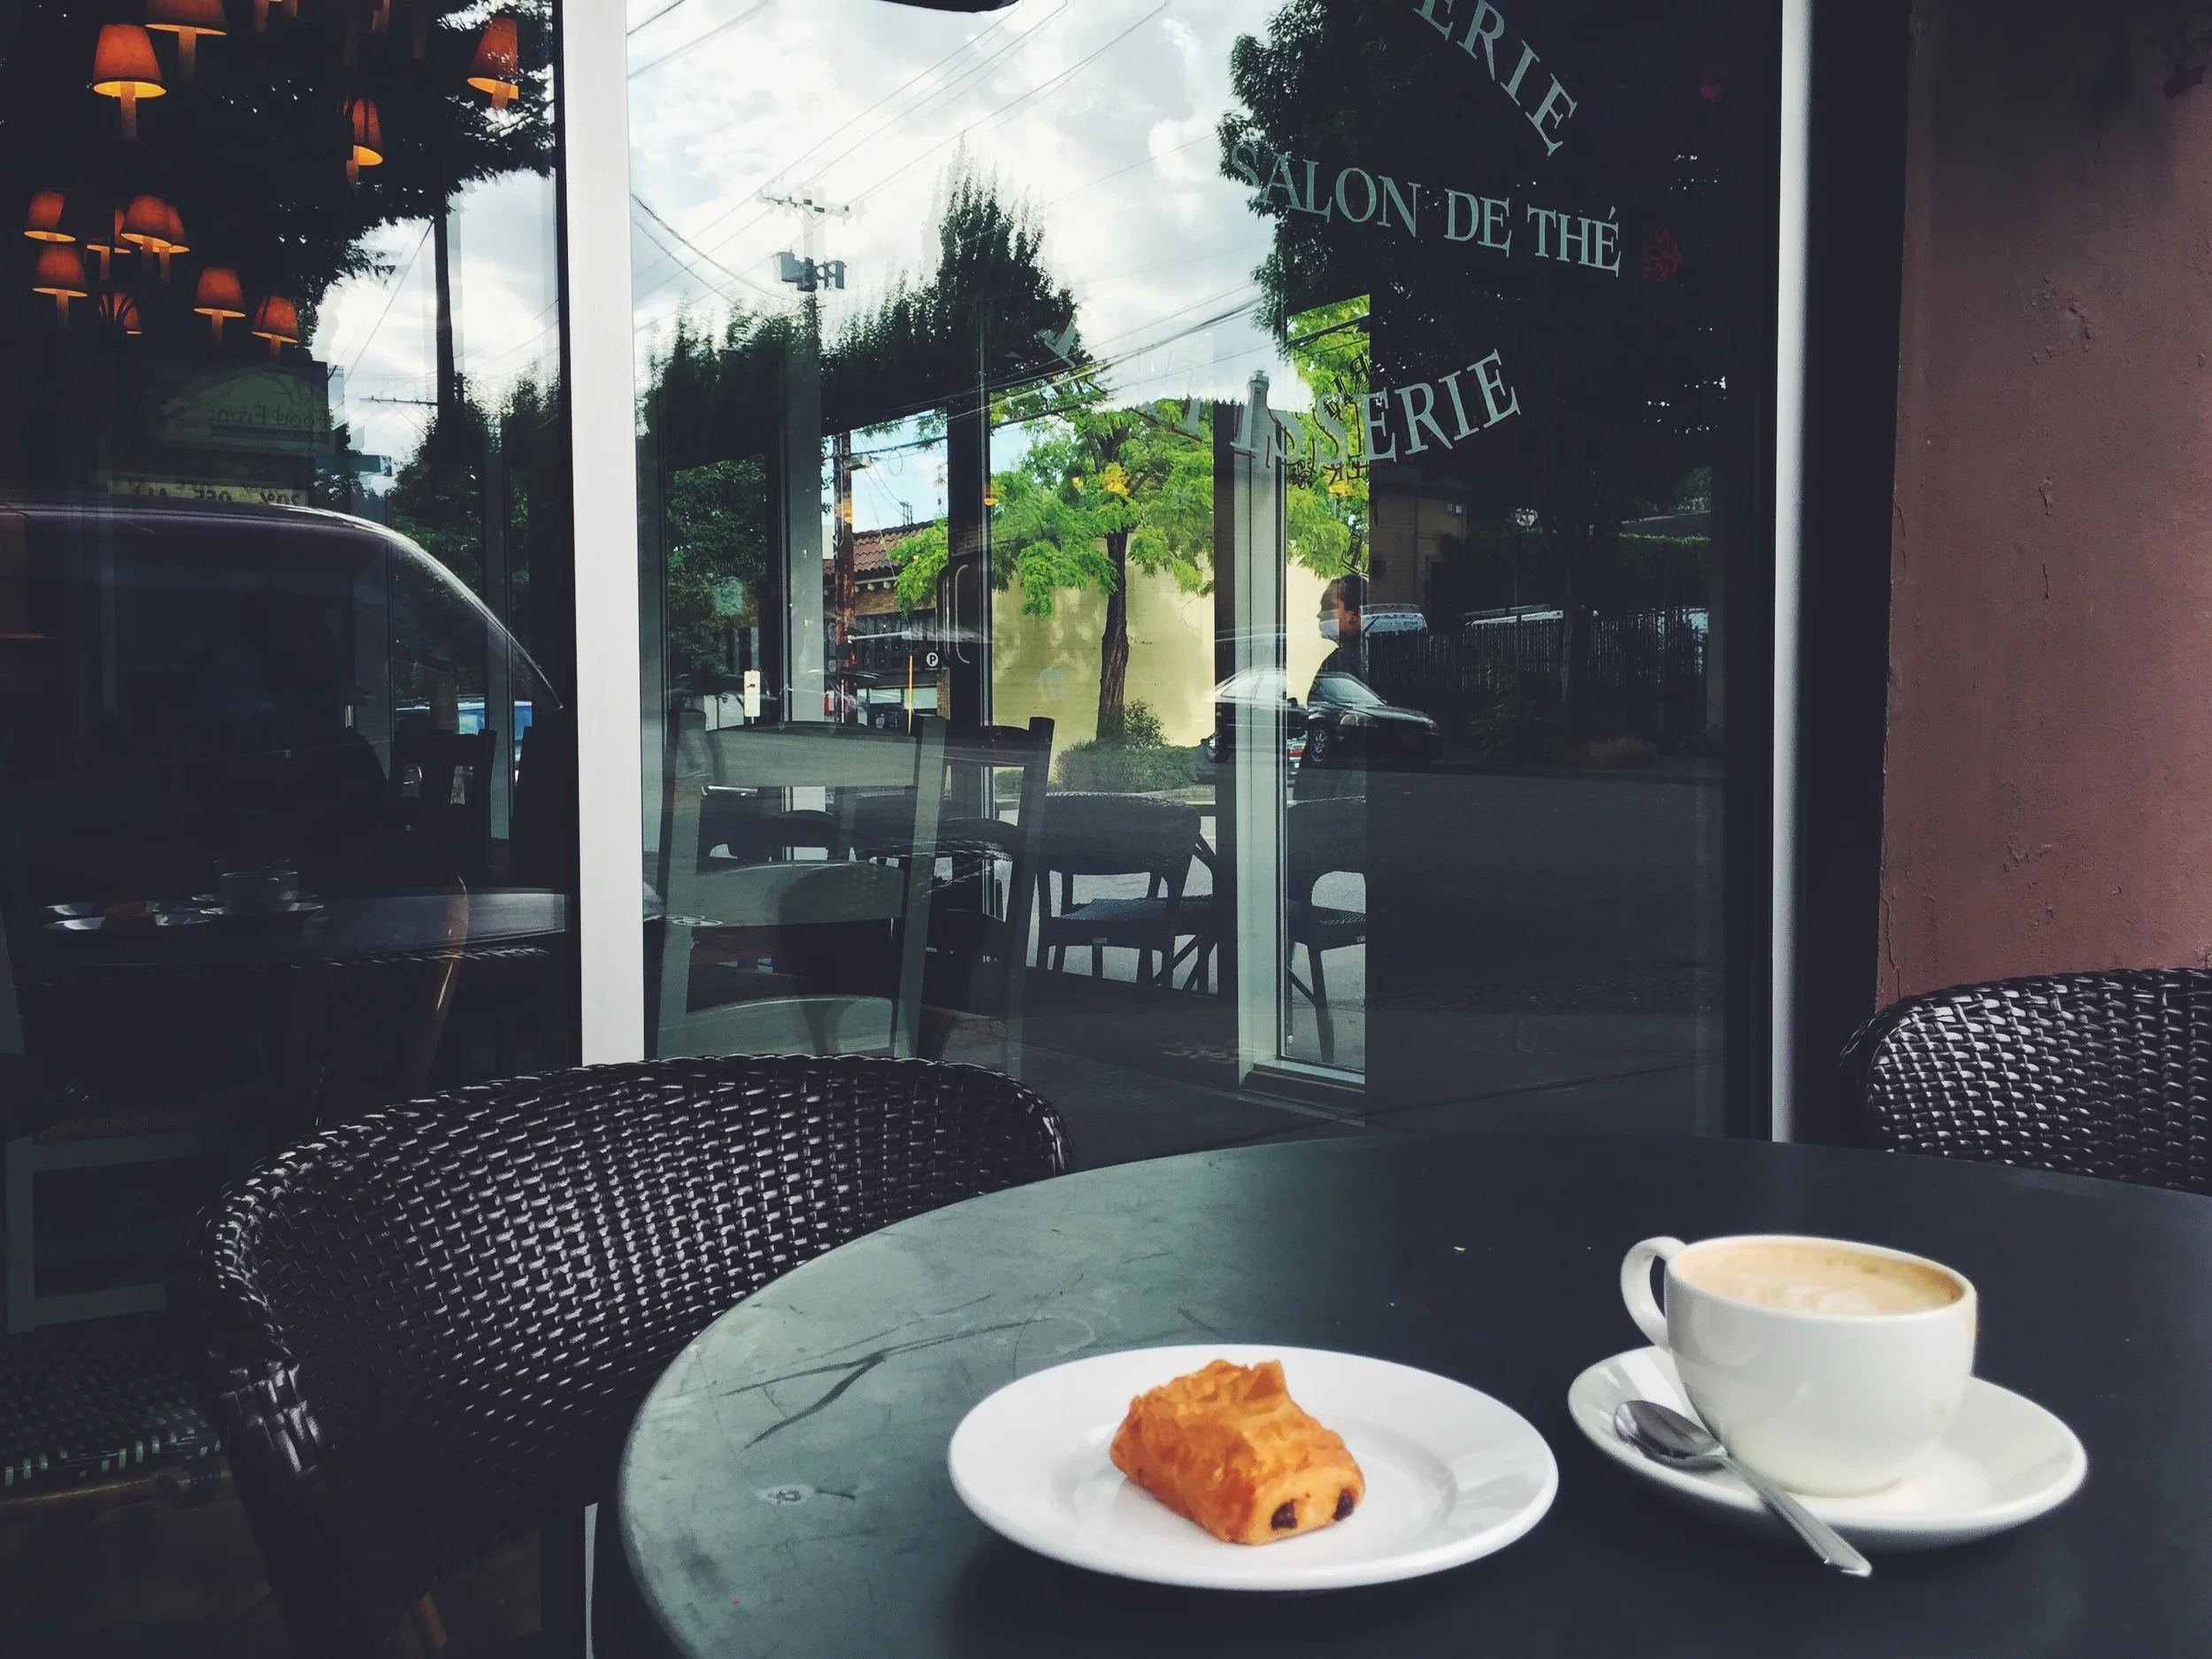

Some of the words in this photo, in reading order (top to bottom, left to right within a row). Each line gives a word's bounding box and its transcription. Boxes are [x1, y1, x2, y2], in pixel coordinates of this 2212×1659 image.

[1231, 143, 1422, 238] SALON
[1443, 188, 1512, 257] DE
[1526, 204, 1622, 278] THÉ
